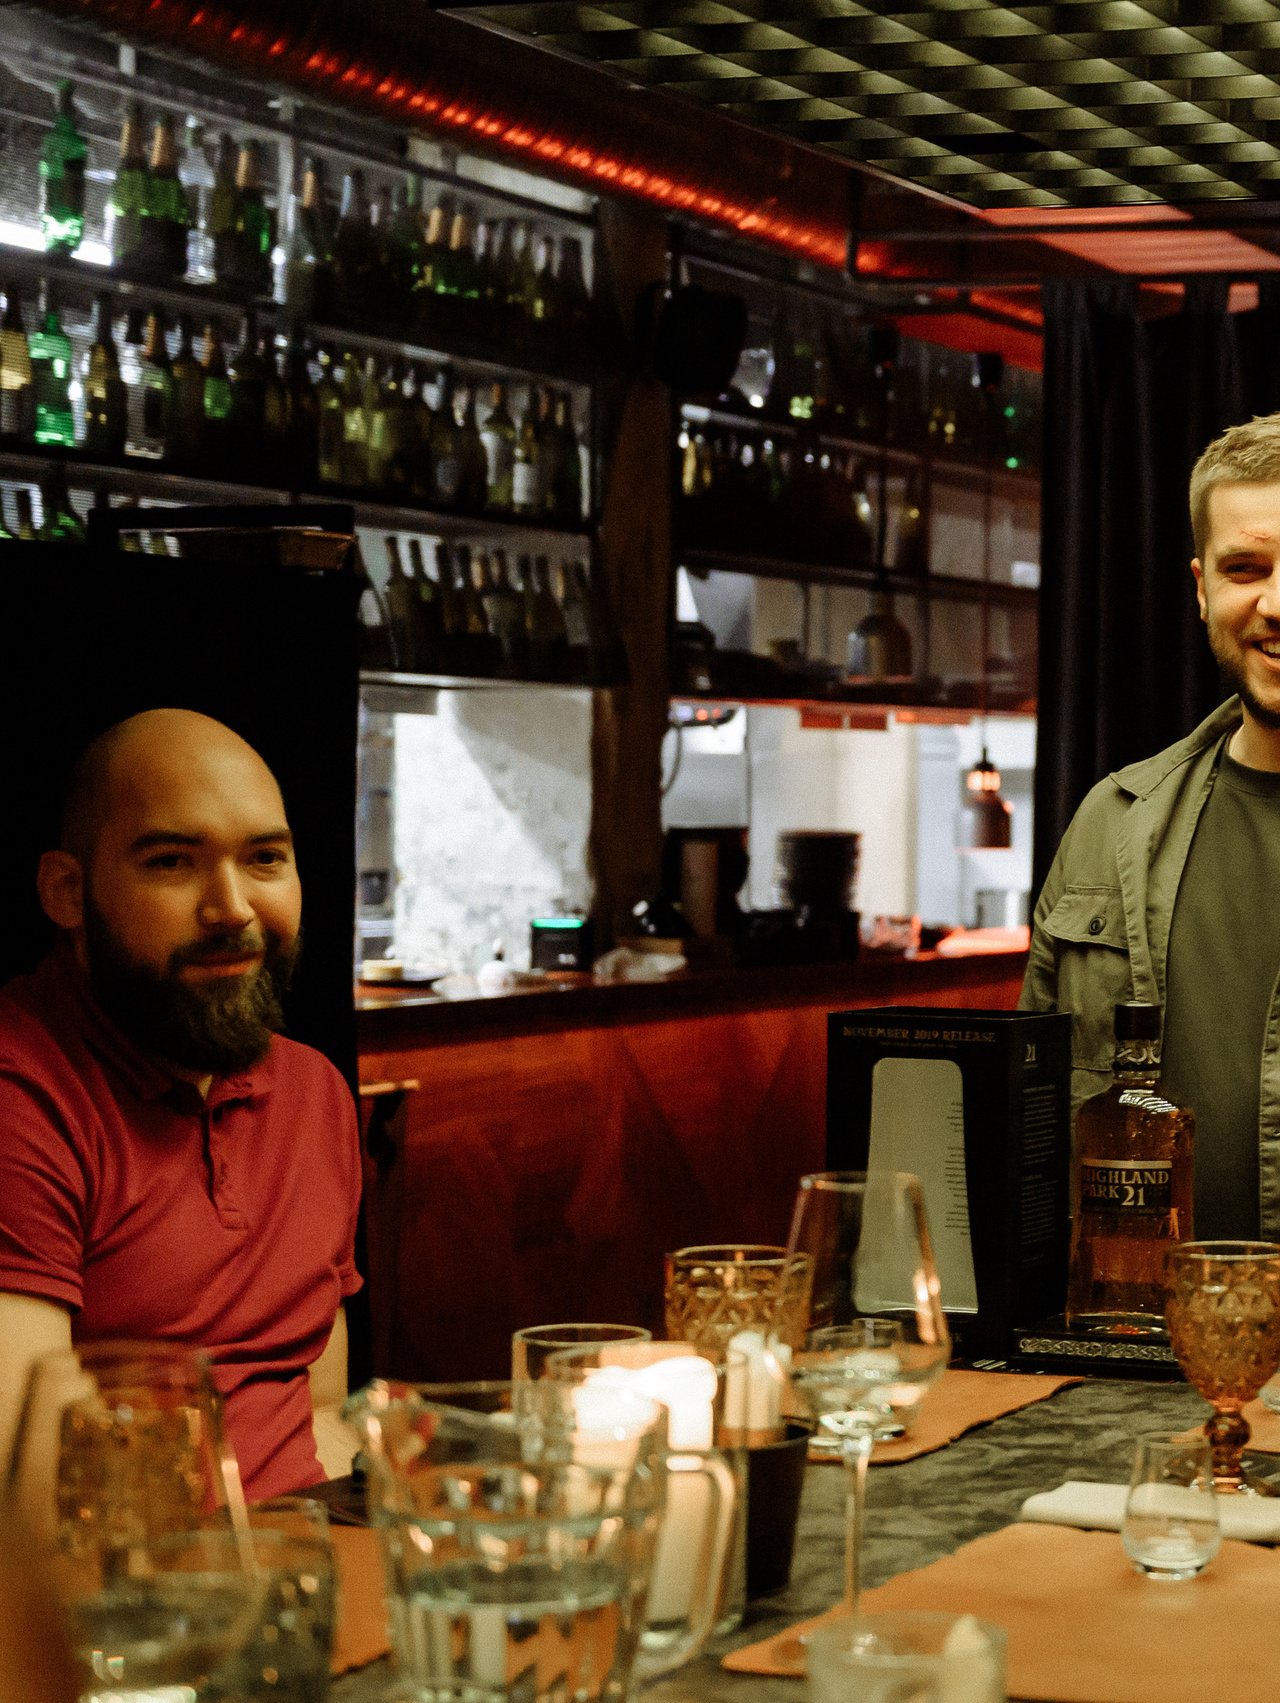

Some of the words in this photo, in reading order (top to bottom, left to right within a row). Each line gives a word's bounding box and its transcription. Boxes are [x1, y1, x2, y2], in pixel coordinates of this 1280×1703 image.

[842, 1026, 910, 1040] NOVEMBER
[914, 1028, 940, 1040] 2019
[942, 1030, 997, 1043] RELEASE
[1024, 1043, 1036, 1062] 21
[1121, 1185, 1146, 1207] 21
